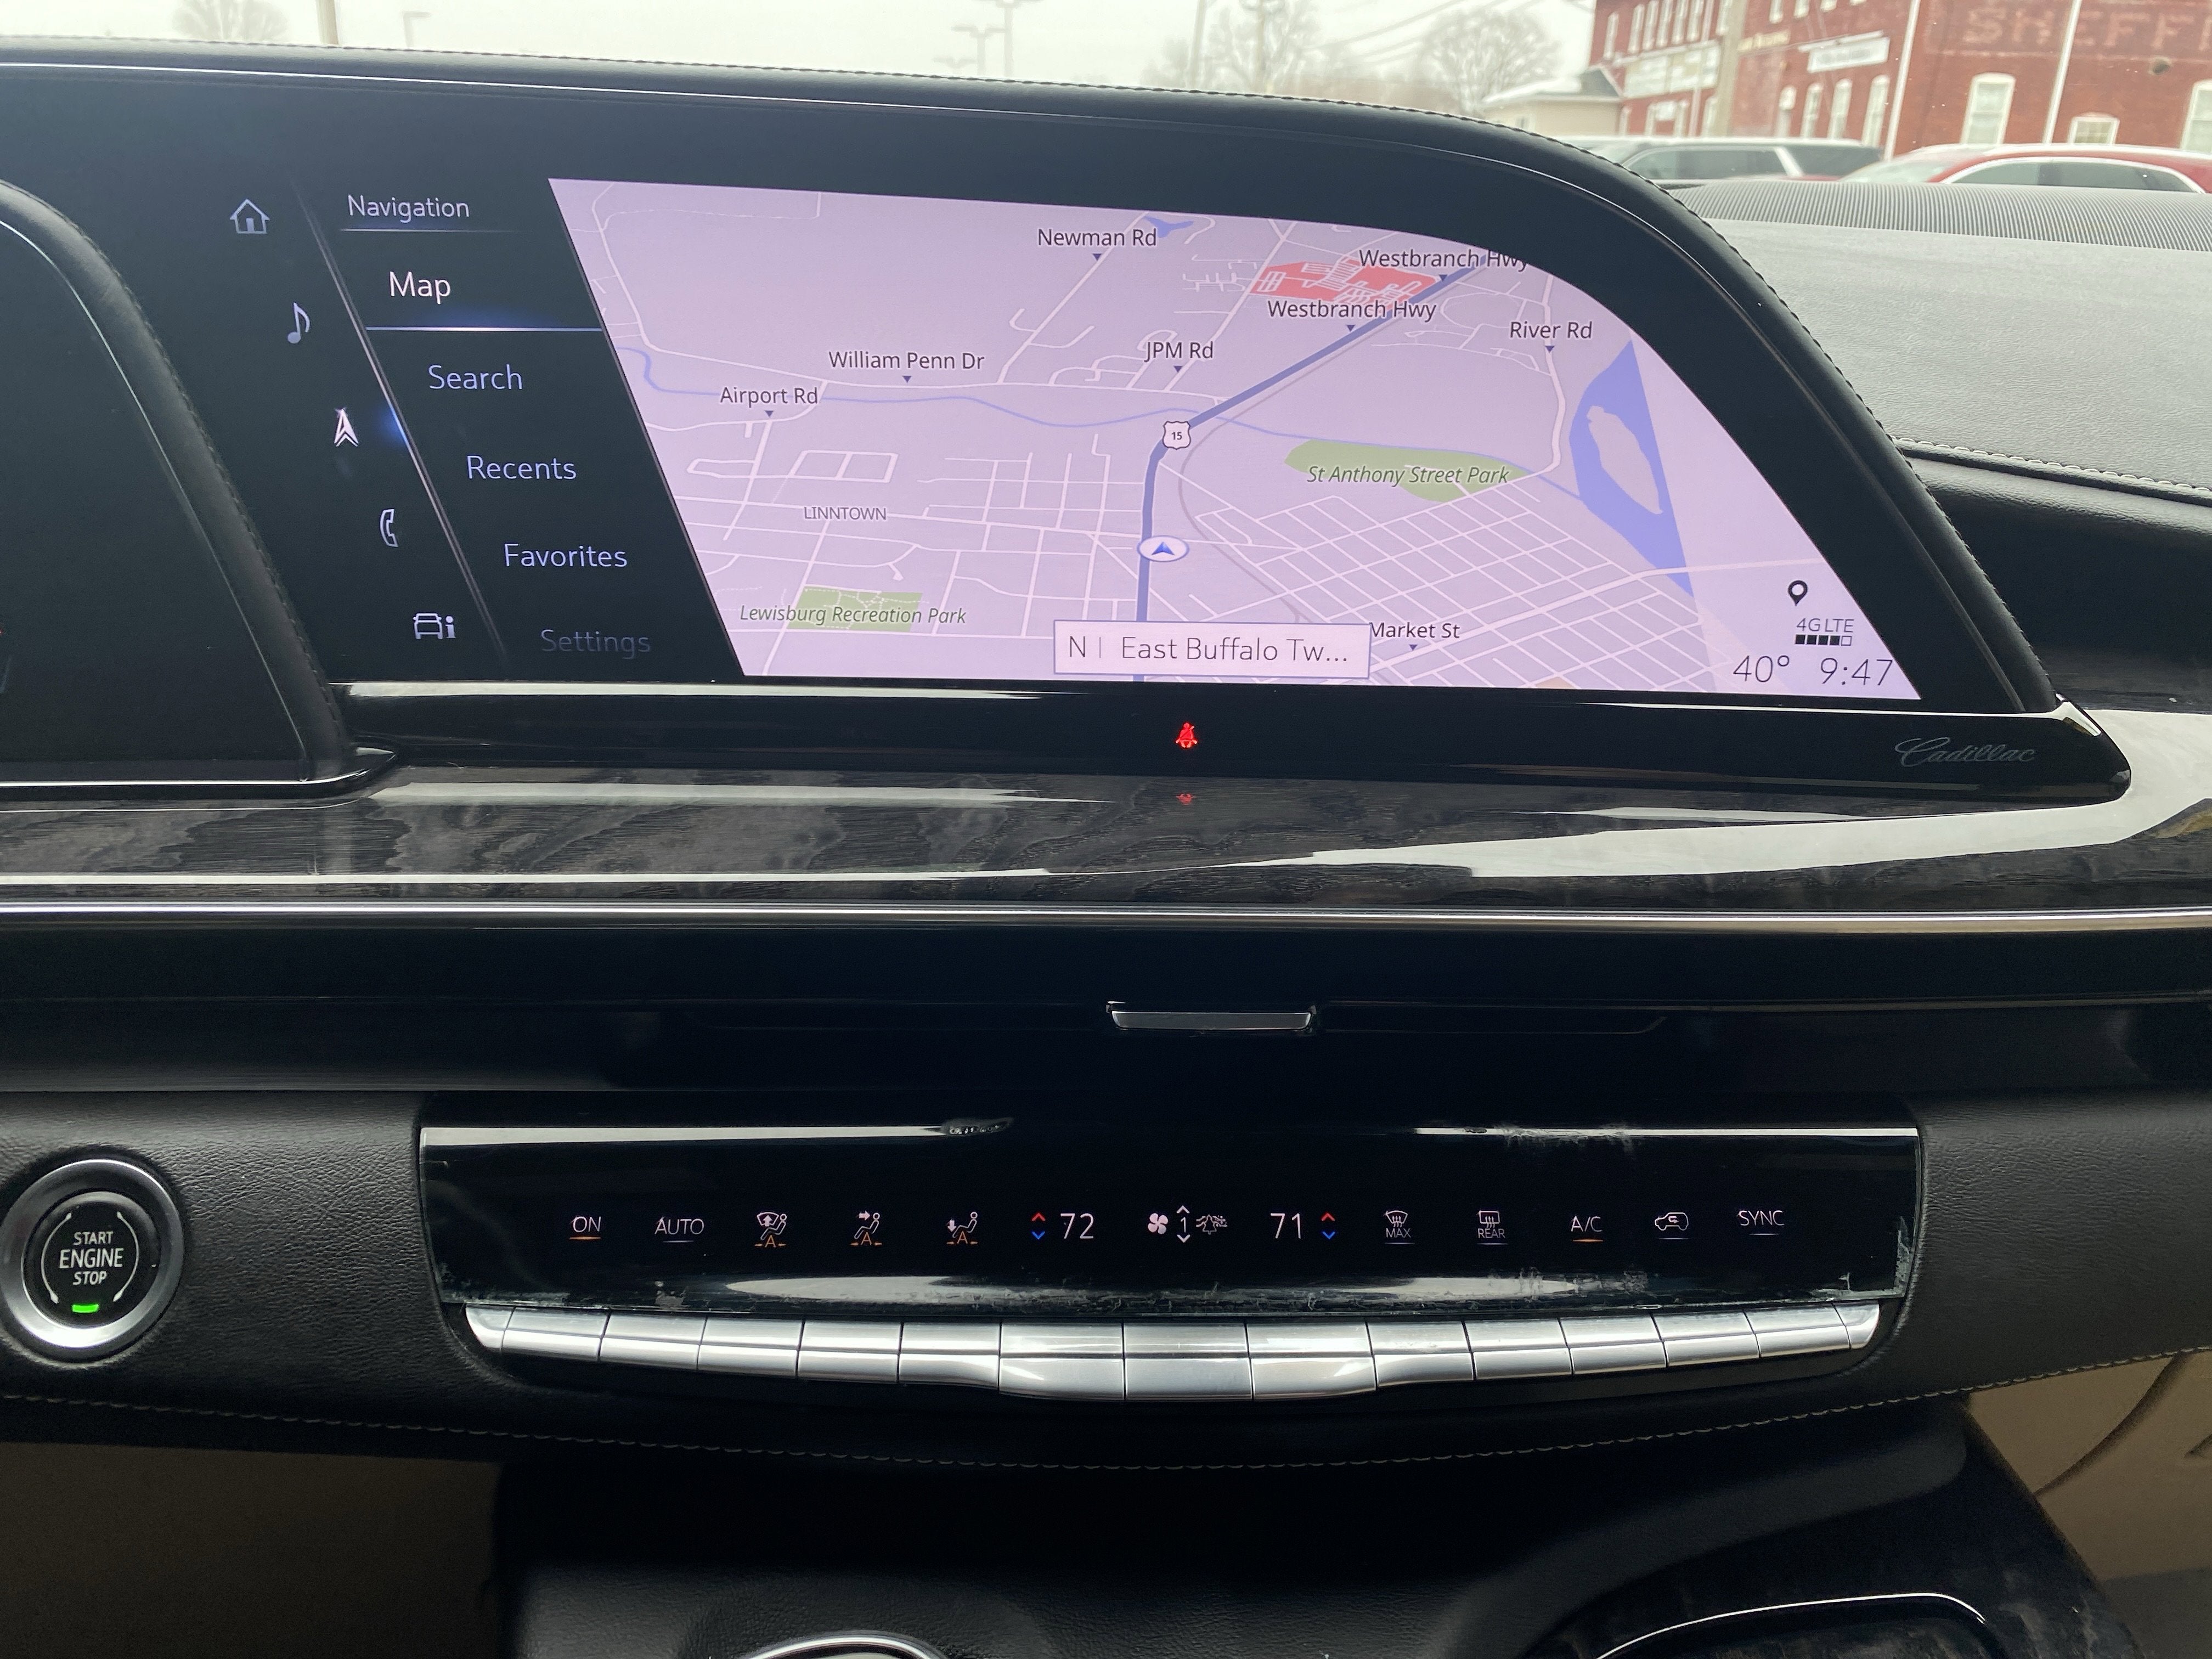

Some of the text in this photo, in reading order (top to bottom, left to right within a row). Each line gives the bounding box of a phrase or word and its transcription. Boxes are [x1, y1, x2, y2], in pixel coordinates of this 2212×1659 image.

[348, 195, 469, 223] Navigation
[1039, 228, 1156, 246] Newman Rd
[1359, 249, 1529, 272] Westbranch Hwy
[390, 272, 450, 304] Map
[1268, 300, 1436, 322] Westbranch Hwy
[1511, 321, 1592, 338] River Rd
[829, 351, 984, 369] William Penn Dr
[1144, 341, 1213, 362] JPM Rd
[429, 364, 522, 389] Search
[720, 387, 817, 410] Airport Rd
[1171, 431, 1183, 441] 15
[467, 456, 576, 479] Recents
[1307, 466, 1509, 487] St Anthony Street Park
[804, 507, 885, 520] LINNTOWN
[505, 544, 627, 567] Favorites
[741, 605, 966, 625] Lewisburg Recreation Park
[1370, 622, 1460, 638] Market St
[1797, 618, 1854, 633] 4G LTE
[541, 629, 650, 659] Settings
[1070, 636, 1346, 661] N East Buffalo Tw...
[1820, 657, 1893, 686] 9:47
[1894, 737, 2034, 766] Cadillac
[572, 1216, 601, 1233] ON
[654, 1217, 704, 1234] AUTO
[1060, 1213, 1093, 1239] 72
[1180, 1217, 1187, 1233] 1
[1271, 1213, 1300, 1238] 71
[1571, 1216, 1602, 1233] A/C
[1739, 1210, 1784, 1226] SYNC
[74, 1232, 113, 1245] START
[1386, 1228, 1412, 1239] MAX
[1477, 1228, 1506, 1239] REAR
[60, 1248, 123, 1268] ENGINE
[72, 1271, 106, 1285] STOP
